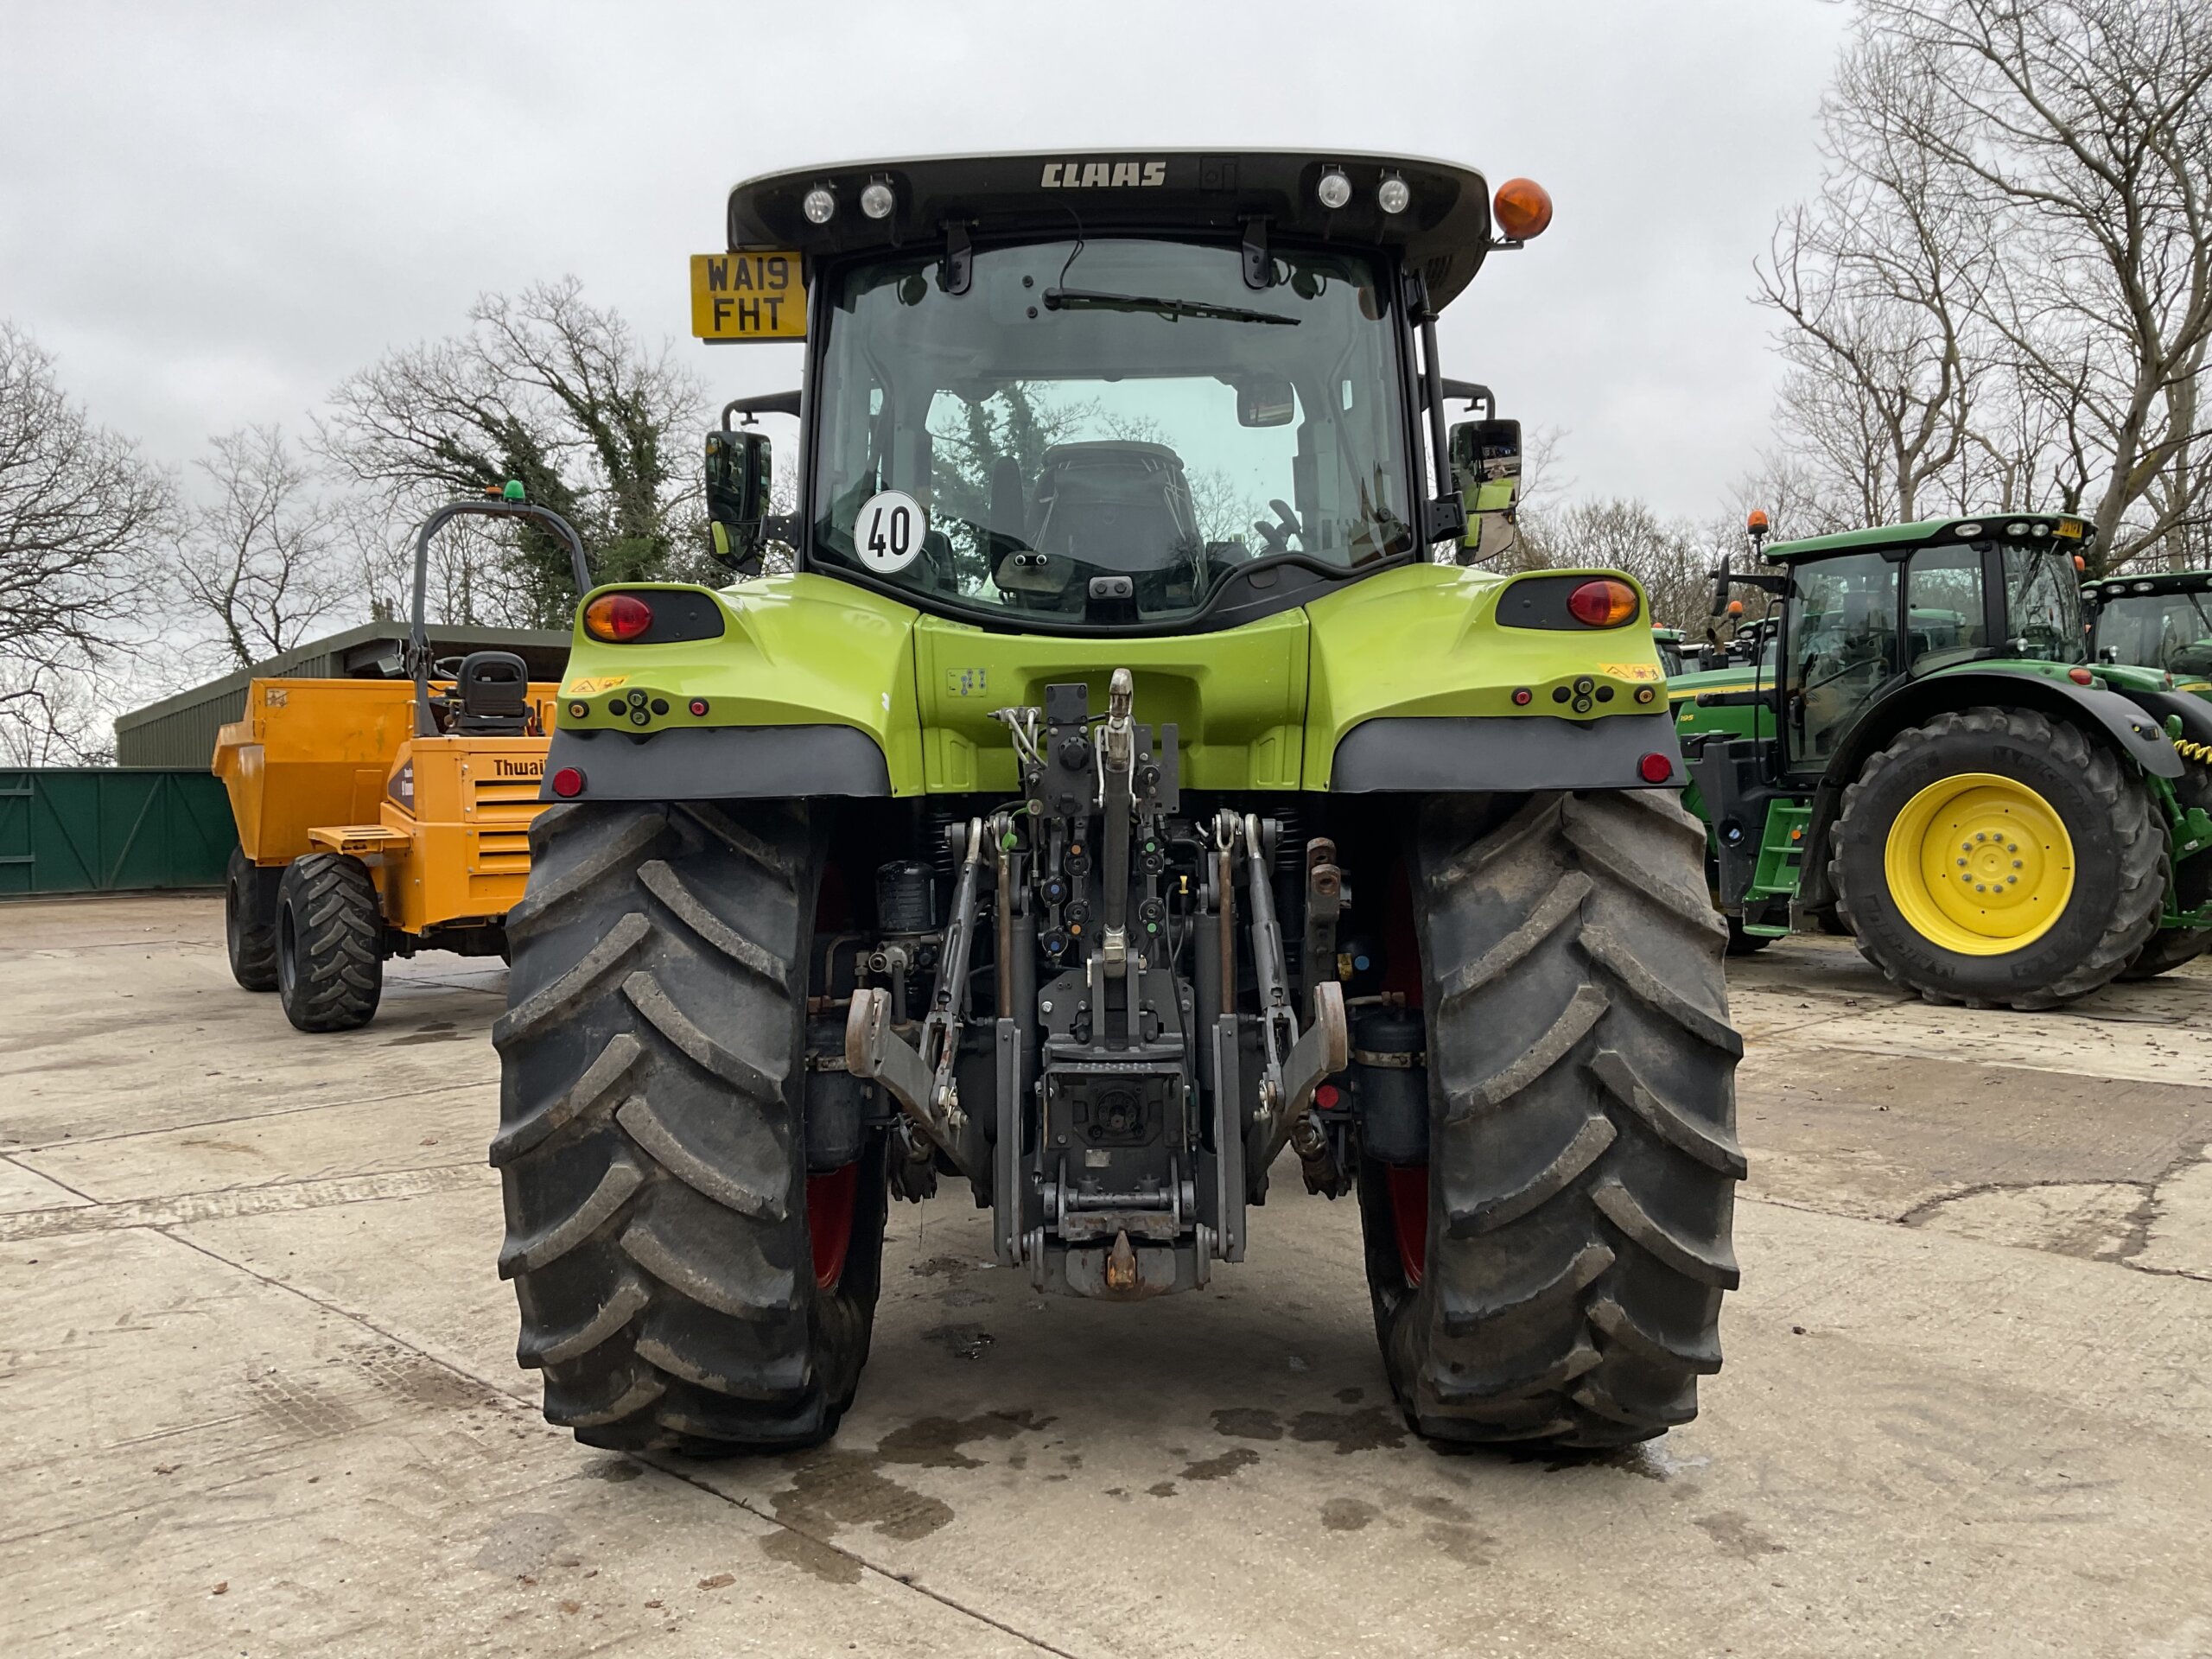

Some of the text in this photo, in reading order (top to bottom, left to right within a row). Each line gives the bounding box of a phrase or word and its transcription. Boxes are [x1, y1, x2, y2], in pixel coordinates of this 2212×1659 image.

[1041, 162, 1166, 188] CLAAS
[708, 257, 789, 291] WA19
[714, 297, 785, 332] FHT
[868, 505, 910, 558] 40
[493, 759, 547, 776] Thwai
